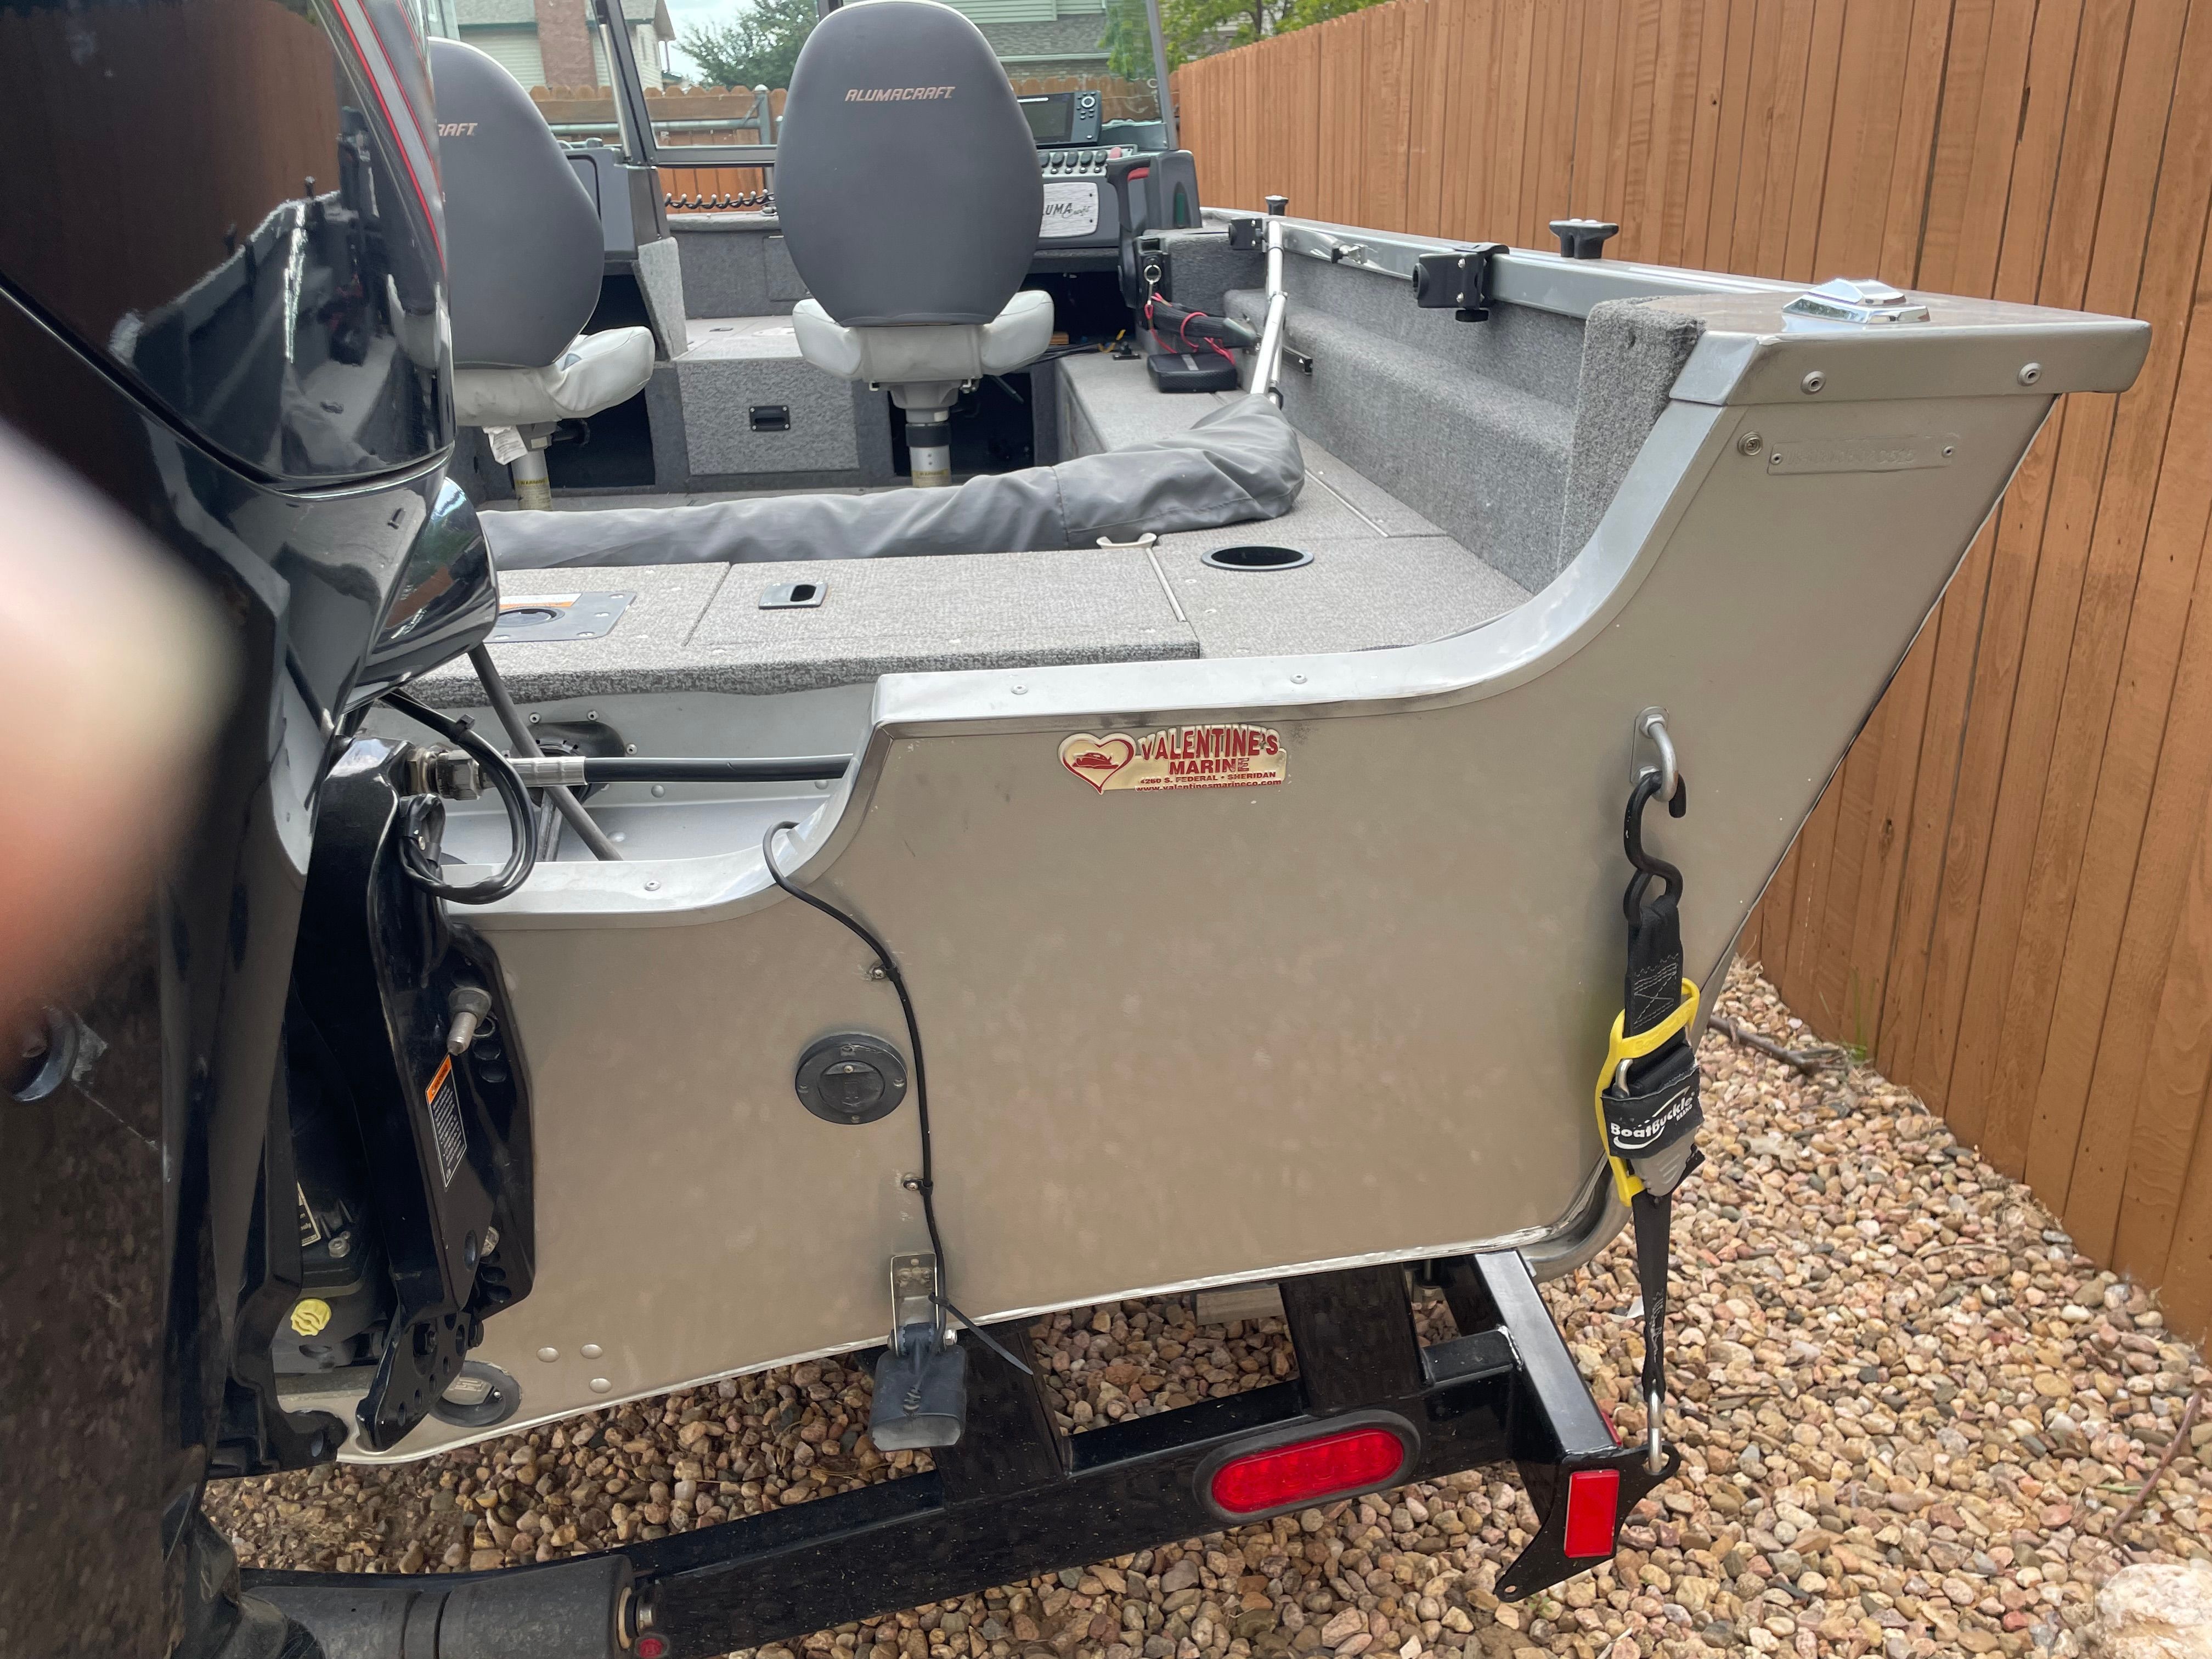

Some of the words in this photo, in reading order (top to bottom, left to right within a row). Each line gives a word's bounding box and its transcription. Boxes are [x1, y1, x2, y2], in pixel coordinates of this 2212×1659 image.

[845, 86, 956, 101] ALUMACRAFT
[1139, 727, 1279, 761] VALENTINE'S
[1169, 758, 1250, 775] MARINE
[1227, 772, 1276, 780] SHERIDAN
[1610, 1097, 1693, 1138] BoatBuckle
